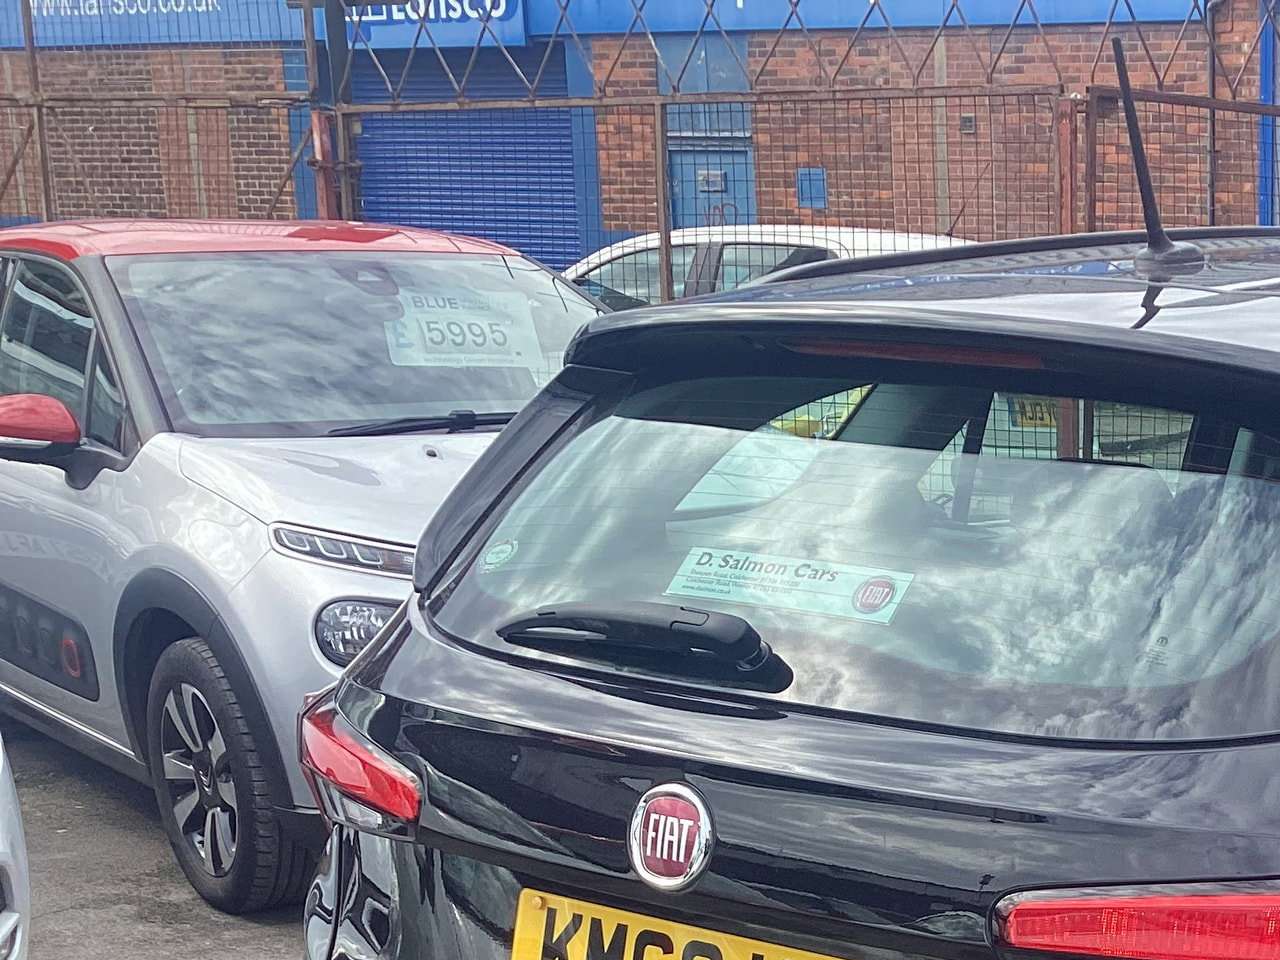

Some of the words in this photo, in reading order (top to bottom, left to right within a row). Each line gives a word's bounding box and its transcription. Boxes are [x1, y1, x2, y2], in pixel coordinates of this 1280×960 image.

[411, 295, 460, 310] BLUE
[425, 320, 509, 348] 5995
[695, 551, 713, 567] D.
[718, 554, 788, 575] Salmon
[794, 563, 839, 582] Cars
[863, 585, 891, 604] FIAT
[646, 812, 695, 863] FIAT
